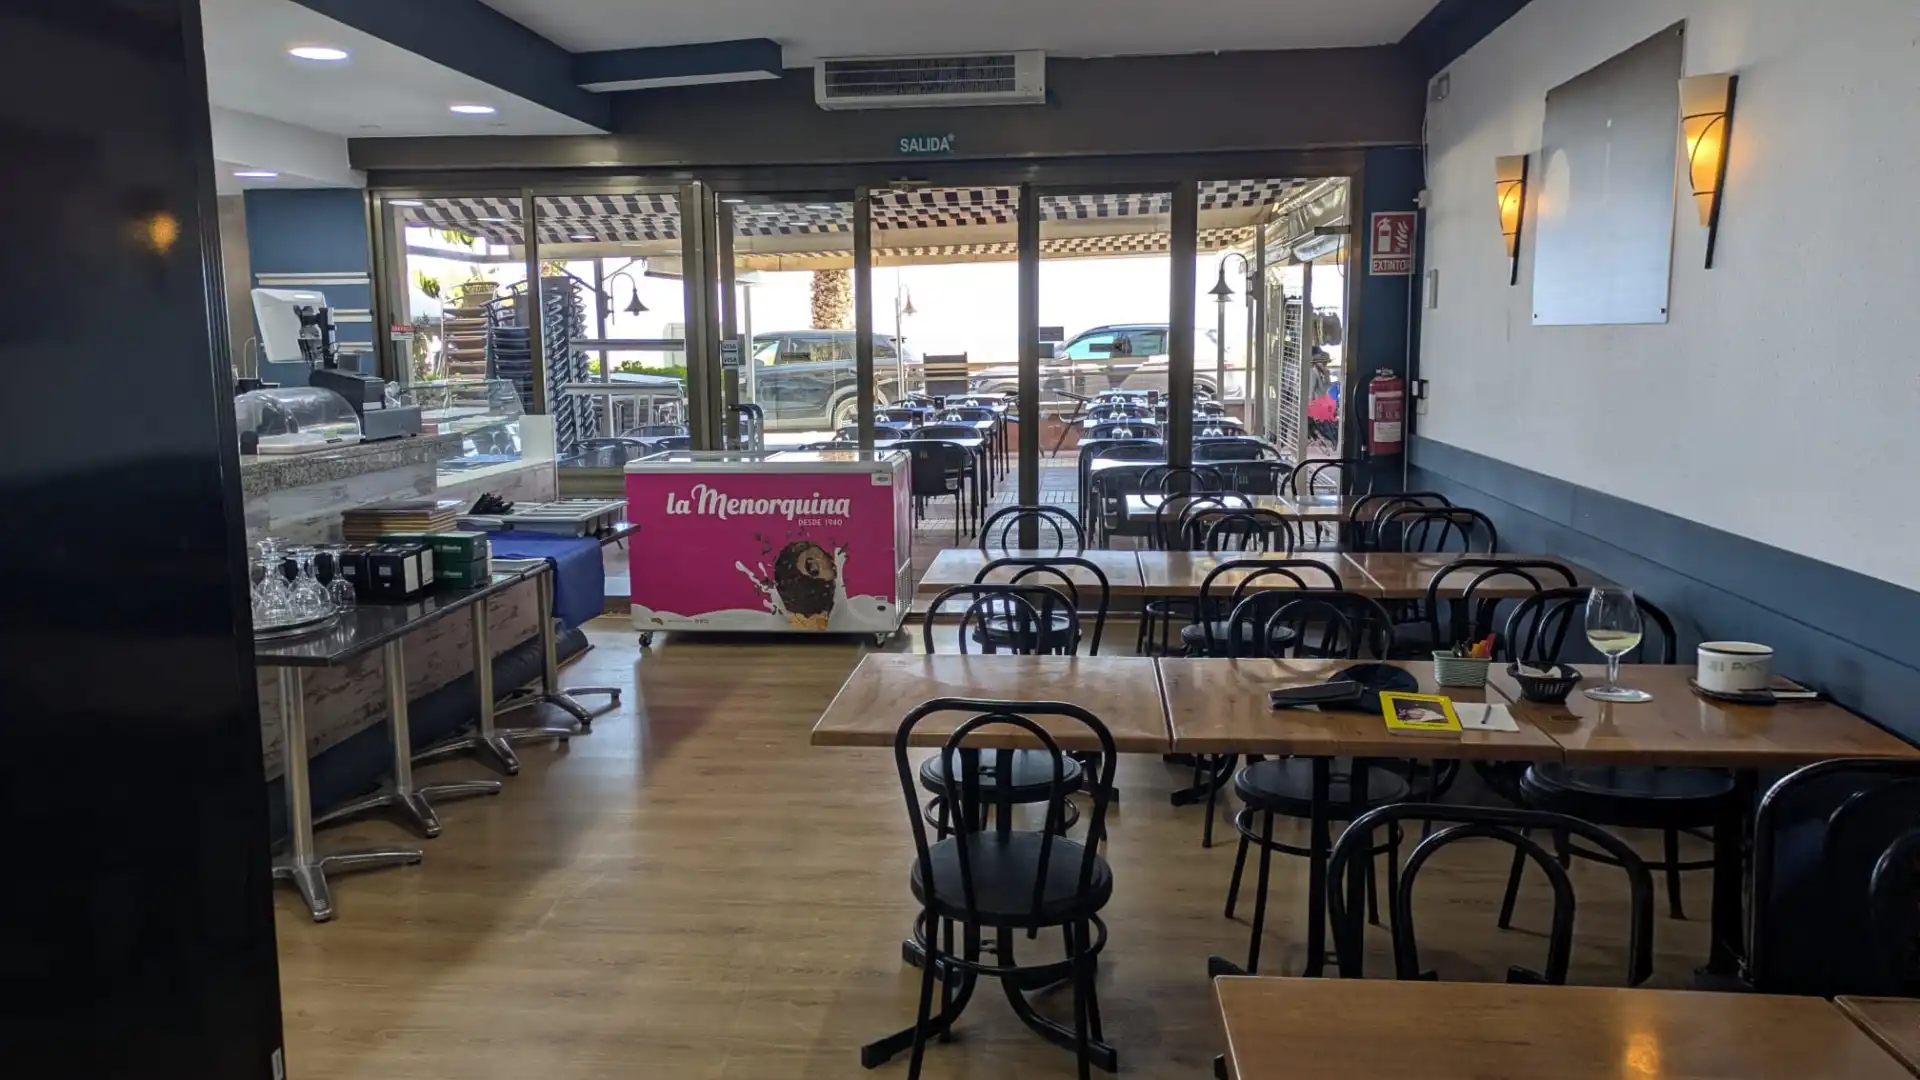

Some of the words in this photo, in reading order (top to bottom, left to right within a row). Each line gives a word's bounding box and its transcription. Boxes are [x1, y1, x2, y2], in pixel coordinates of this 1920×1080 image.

[900, 136, 950, 152] SALIDA
[666, 492, 691, 515] la
[691, 483, 851, 520] Menorquina
[798, 518, 822, 526] DESDE
[825, 518, 843, 526] 1940
